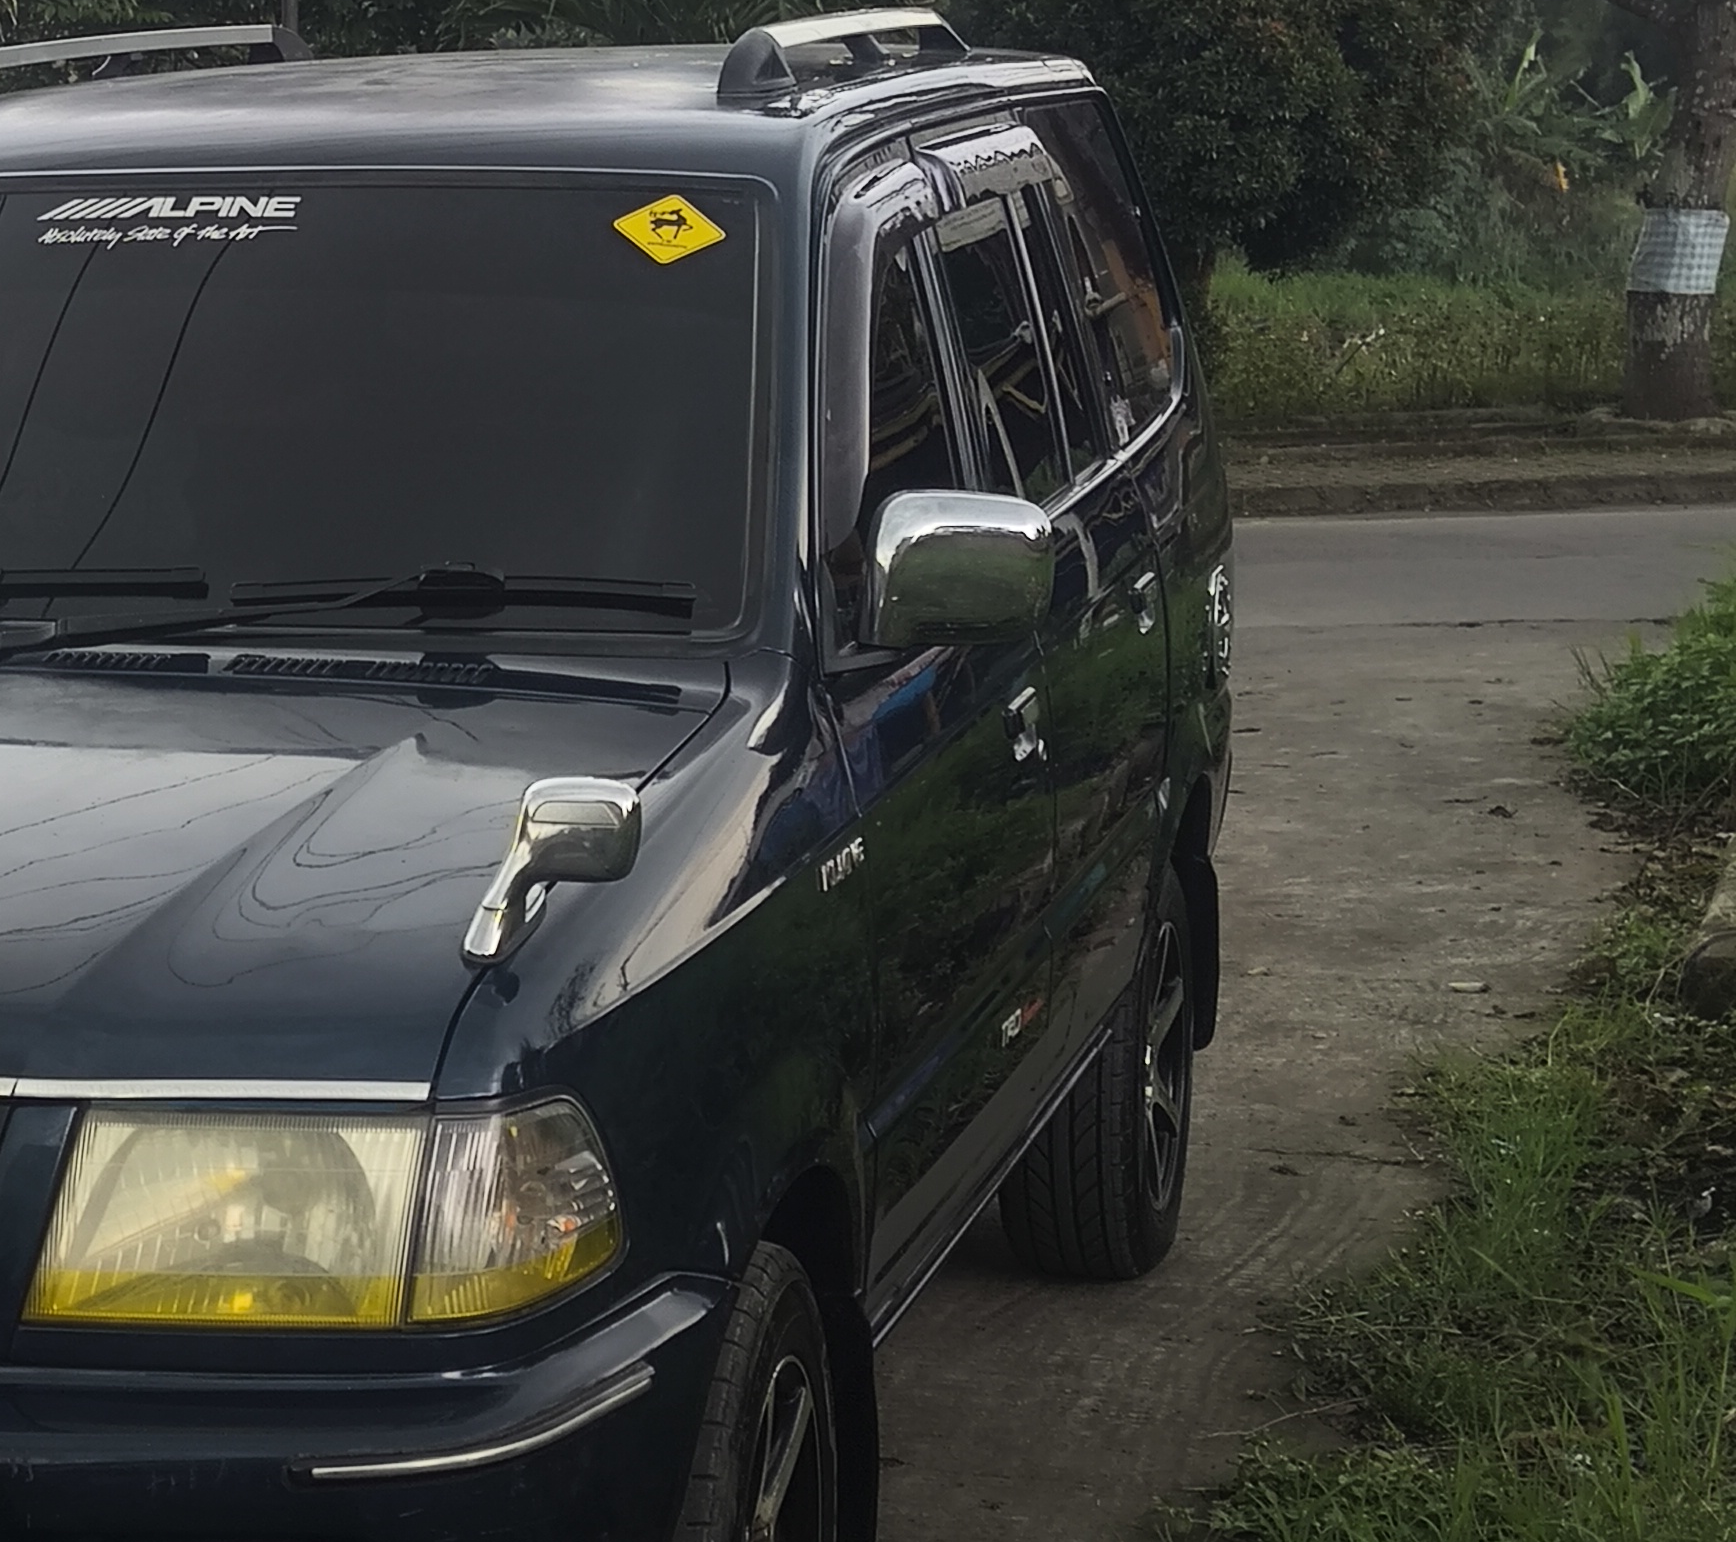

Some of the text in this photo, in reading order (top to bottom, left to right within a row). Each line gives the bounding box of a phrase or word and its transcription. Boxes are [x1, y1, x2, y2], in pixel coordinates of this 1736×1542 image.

[116, 196, 302, 219] ALPINE
[38, 223, 298, 250] Absolutely State of the Art
